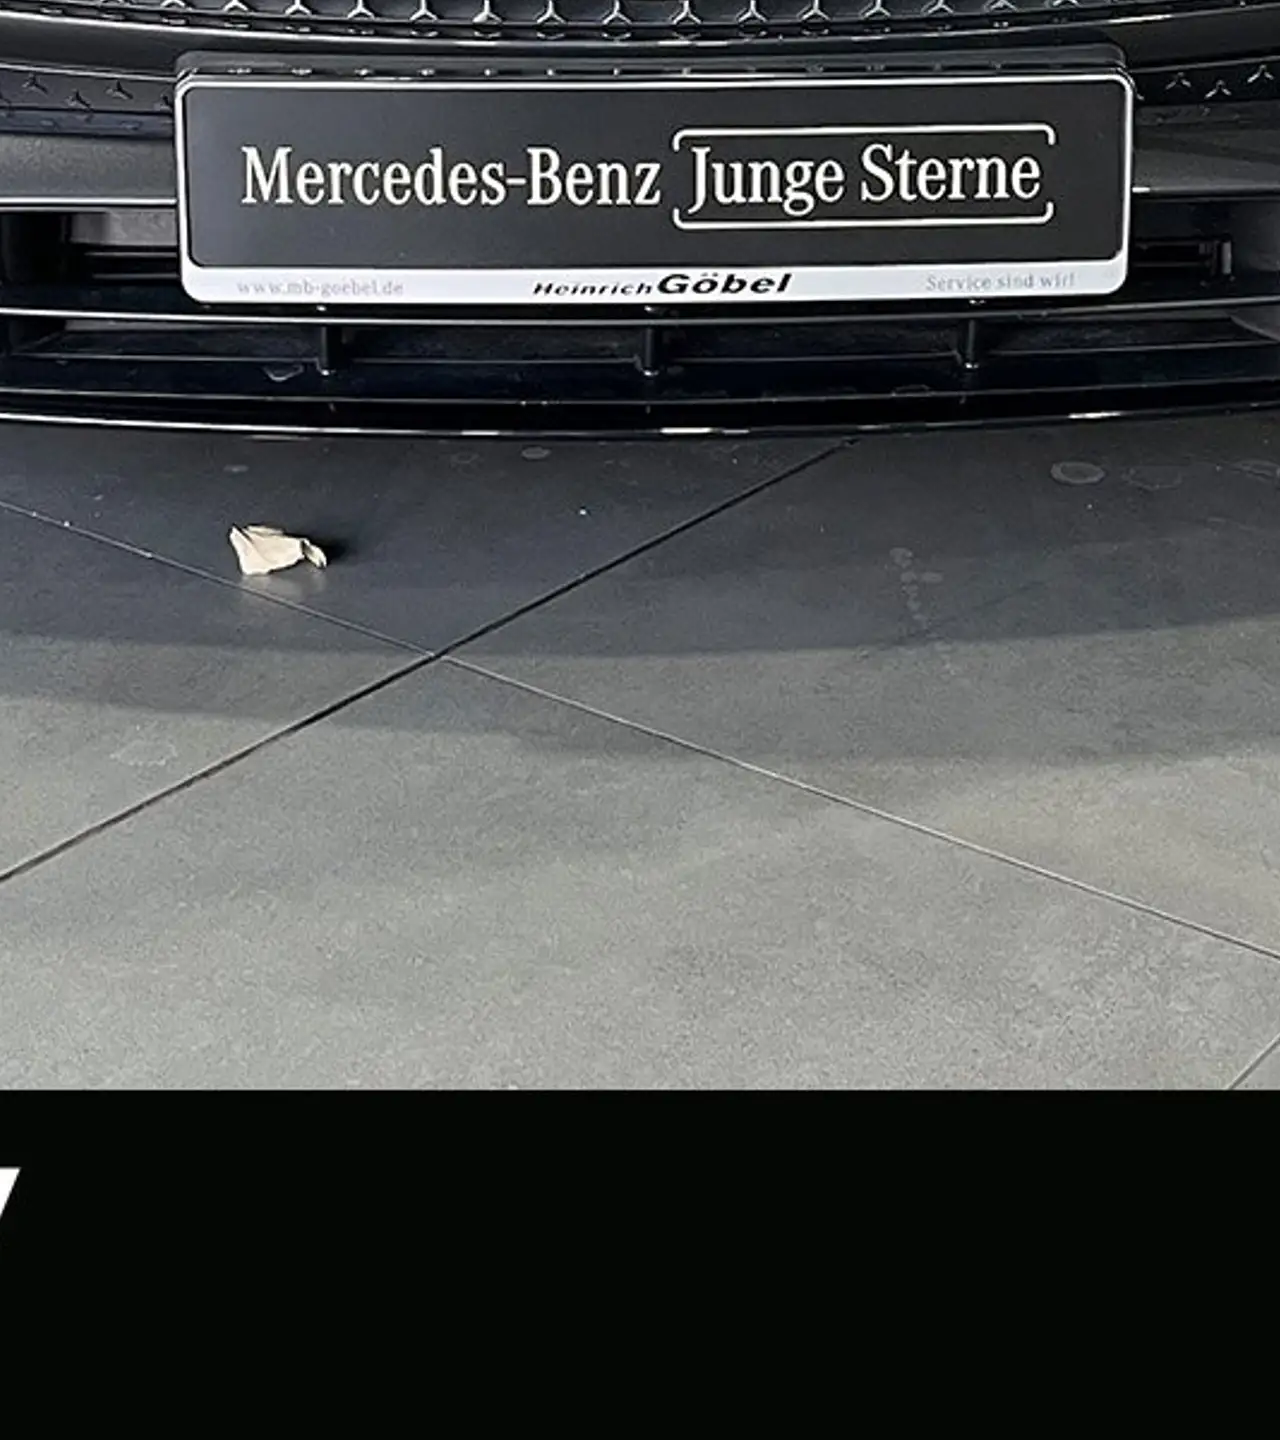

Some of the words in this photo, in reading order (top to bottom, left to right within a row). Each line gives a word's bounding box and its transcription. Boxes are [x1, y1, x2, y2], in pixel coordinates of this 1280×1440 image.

[240, 146, 661, 207] Mercedes-Benz
[687, 146, 846, 217] Junge
[860, 144, 1041, 202] Sterne
[533, 282, 653, 297] Heinrich
[656, 272, 793, 295] Göbel
[925, 273, 992, 292] Service
